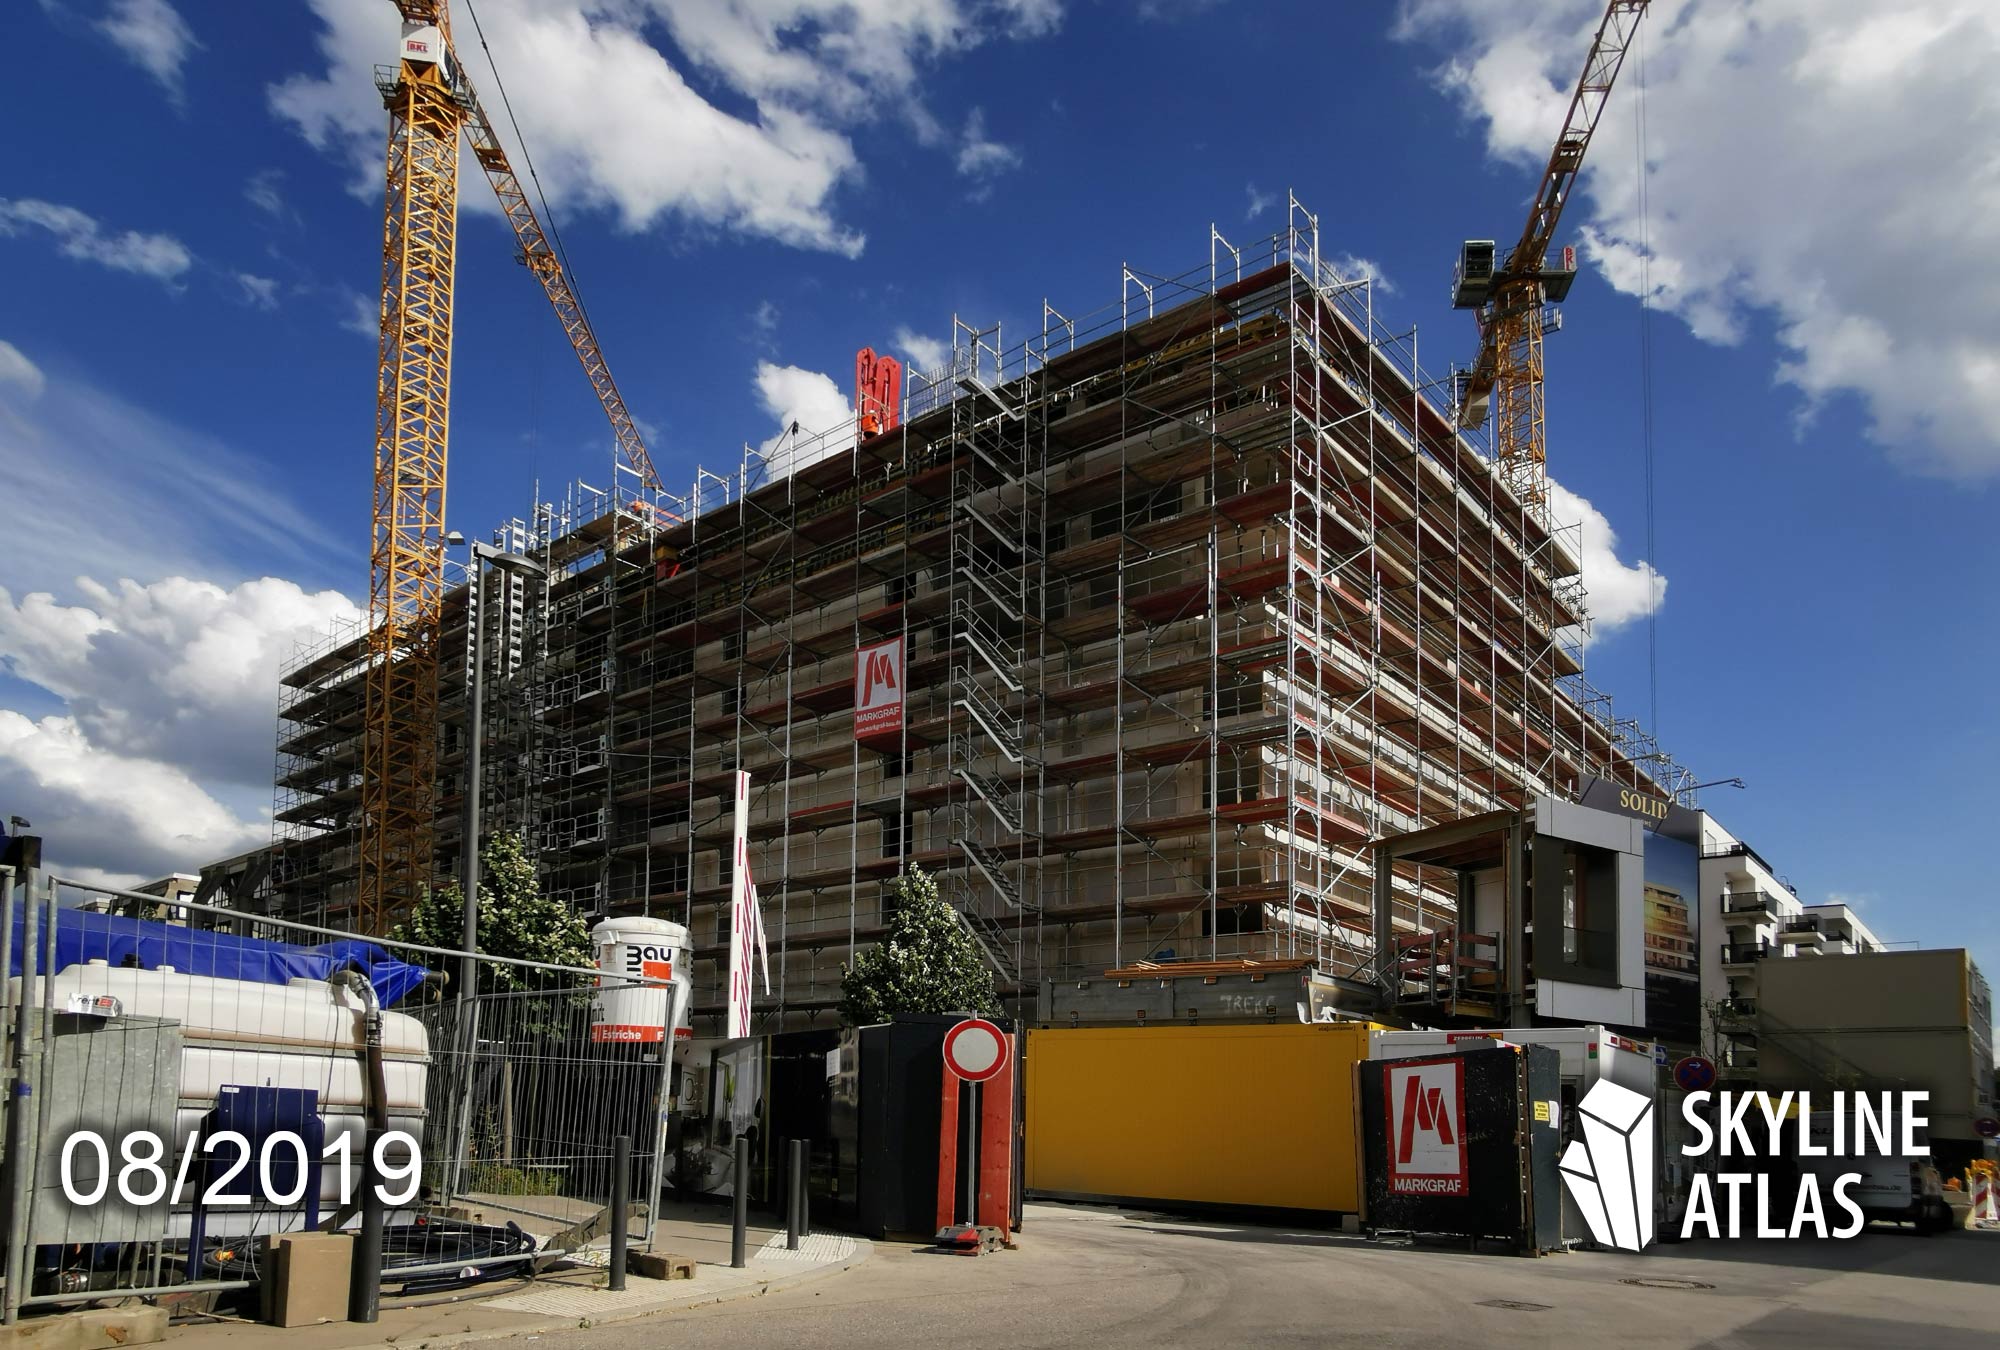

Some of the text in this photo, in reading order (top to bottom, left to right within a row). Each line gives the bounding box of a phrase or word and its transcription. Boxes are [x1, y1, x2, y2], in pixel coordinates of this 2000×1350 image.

[856, 706, 900, 723] MARKGRAF
[1620, 789, 1668, 820] SOLID
[602, 1029, 641, 1040] Estriche
[1395, 1179, 1461, 1193] MARKGRAF
